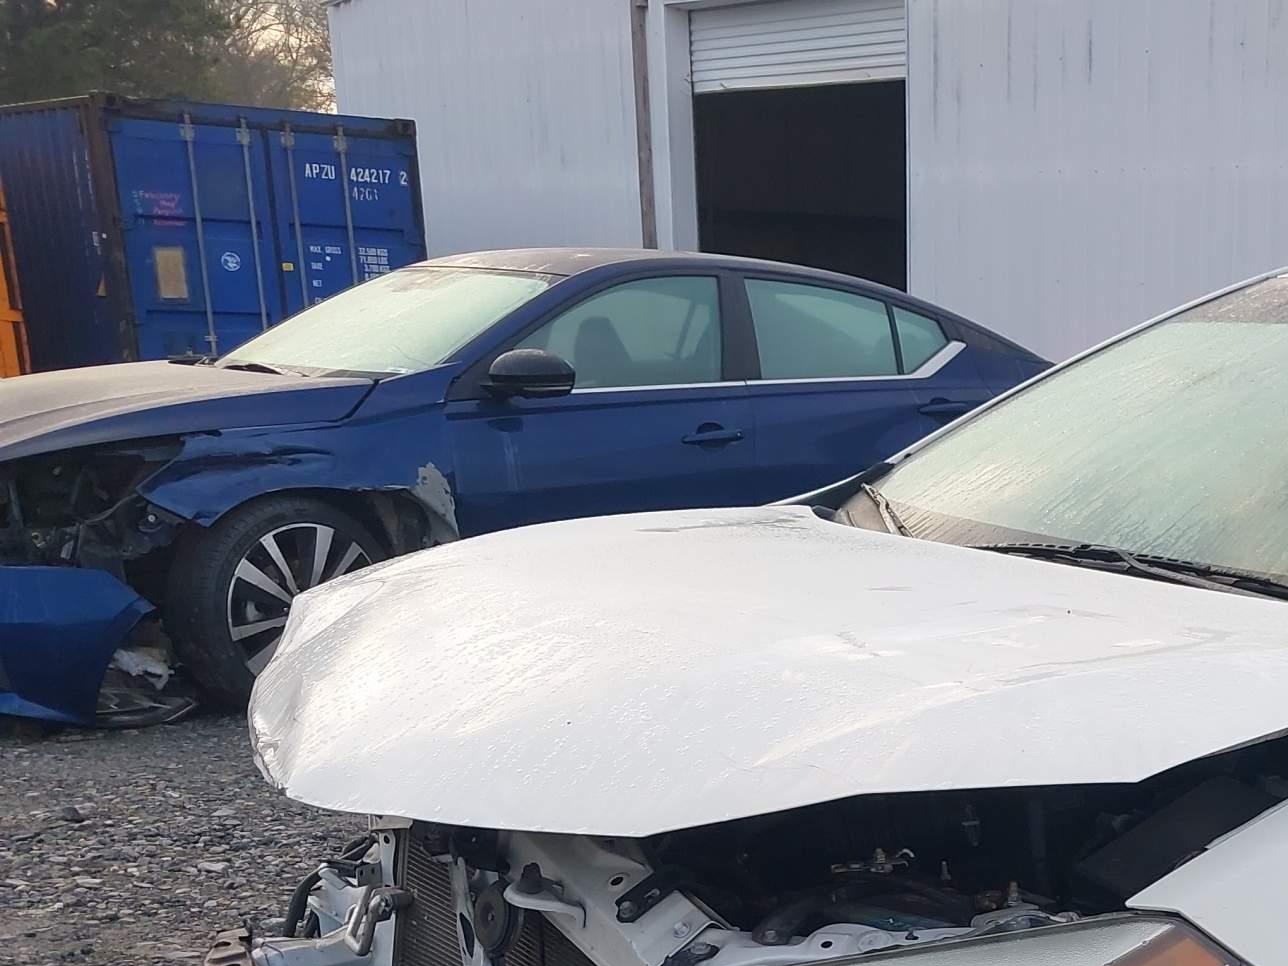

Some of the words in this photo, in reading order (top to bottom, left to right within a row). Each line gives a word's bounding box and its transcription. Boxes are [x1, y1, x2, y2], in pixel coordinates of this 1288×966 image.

[305, 163, 335, 180] APZU
[350, 167, 391, 184] 424217
[400, 171, 408, 185] 2
